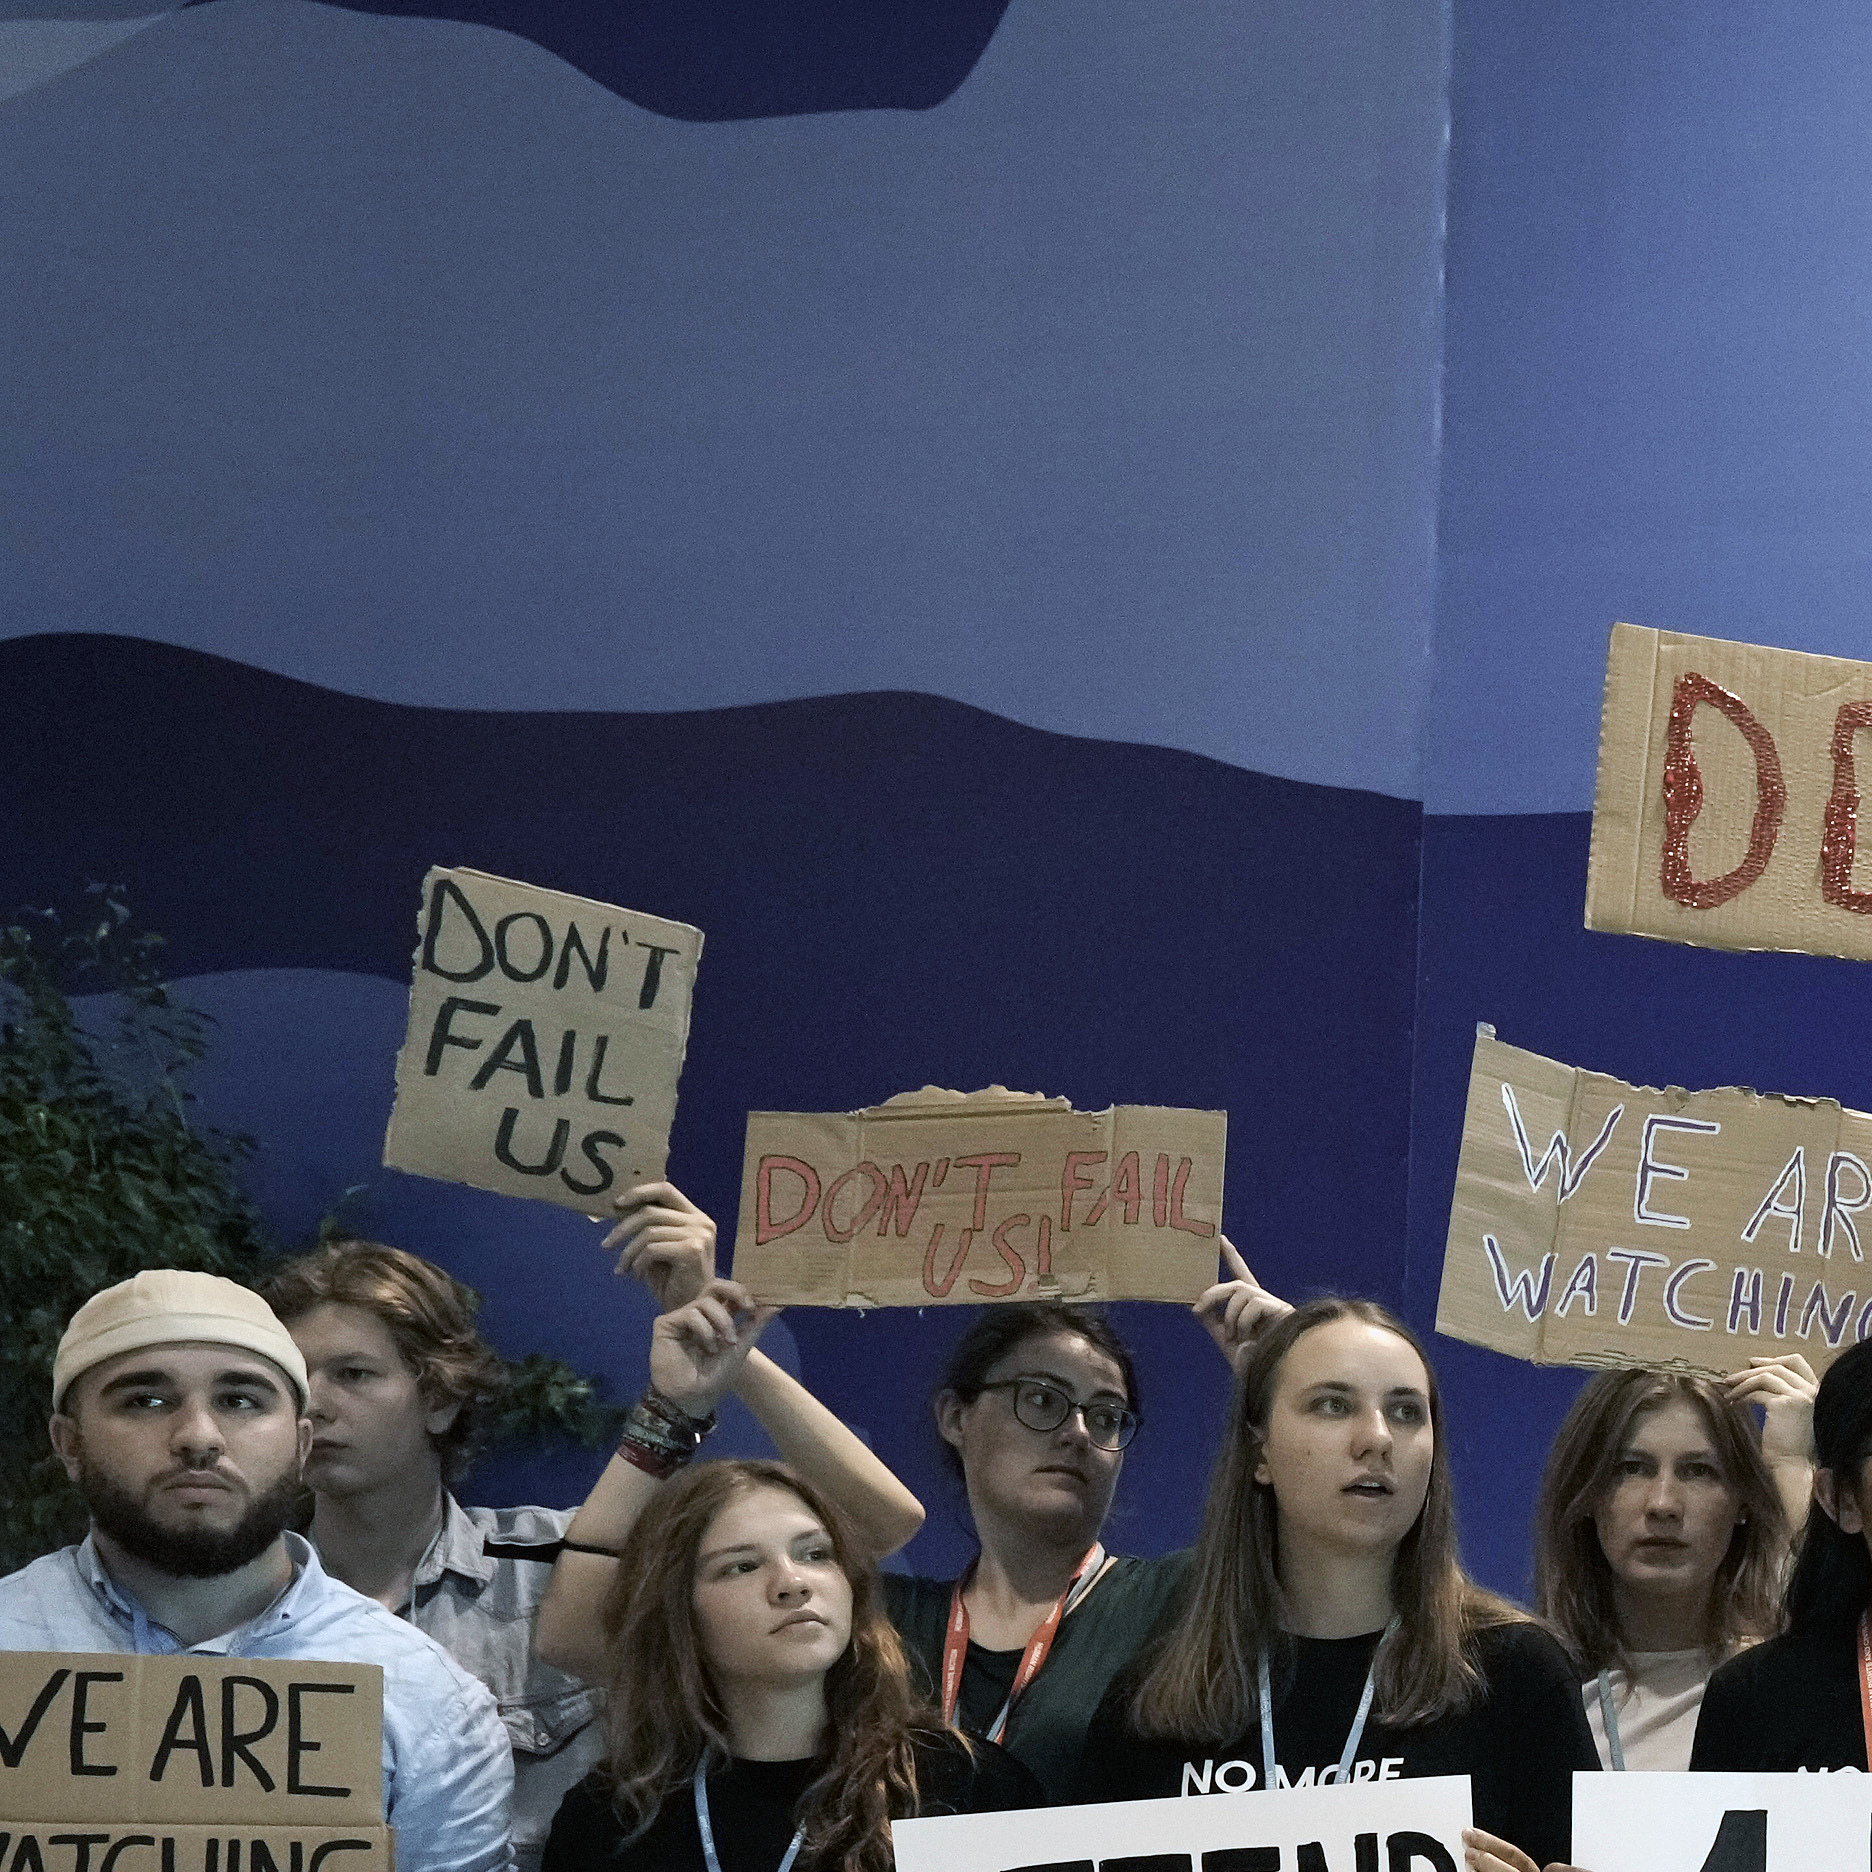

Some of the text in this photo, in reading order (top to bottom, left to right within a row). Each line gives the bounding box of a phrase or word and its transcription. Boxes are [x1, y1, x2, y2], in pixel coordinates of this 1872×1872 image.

[422, 879, 681, 1009] DON'T
[425, 996, 633, 1106] FAIL
[756, 1151, 1215, 1246] DON'T FAIL
[1502, 1083, 1720, 1229] WE
[149, 1675, 355, 1797] ARE
[1181, 1759, 1256, 1797] NO
